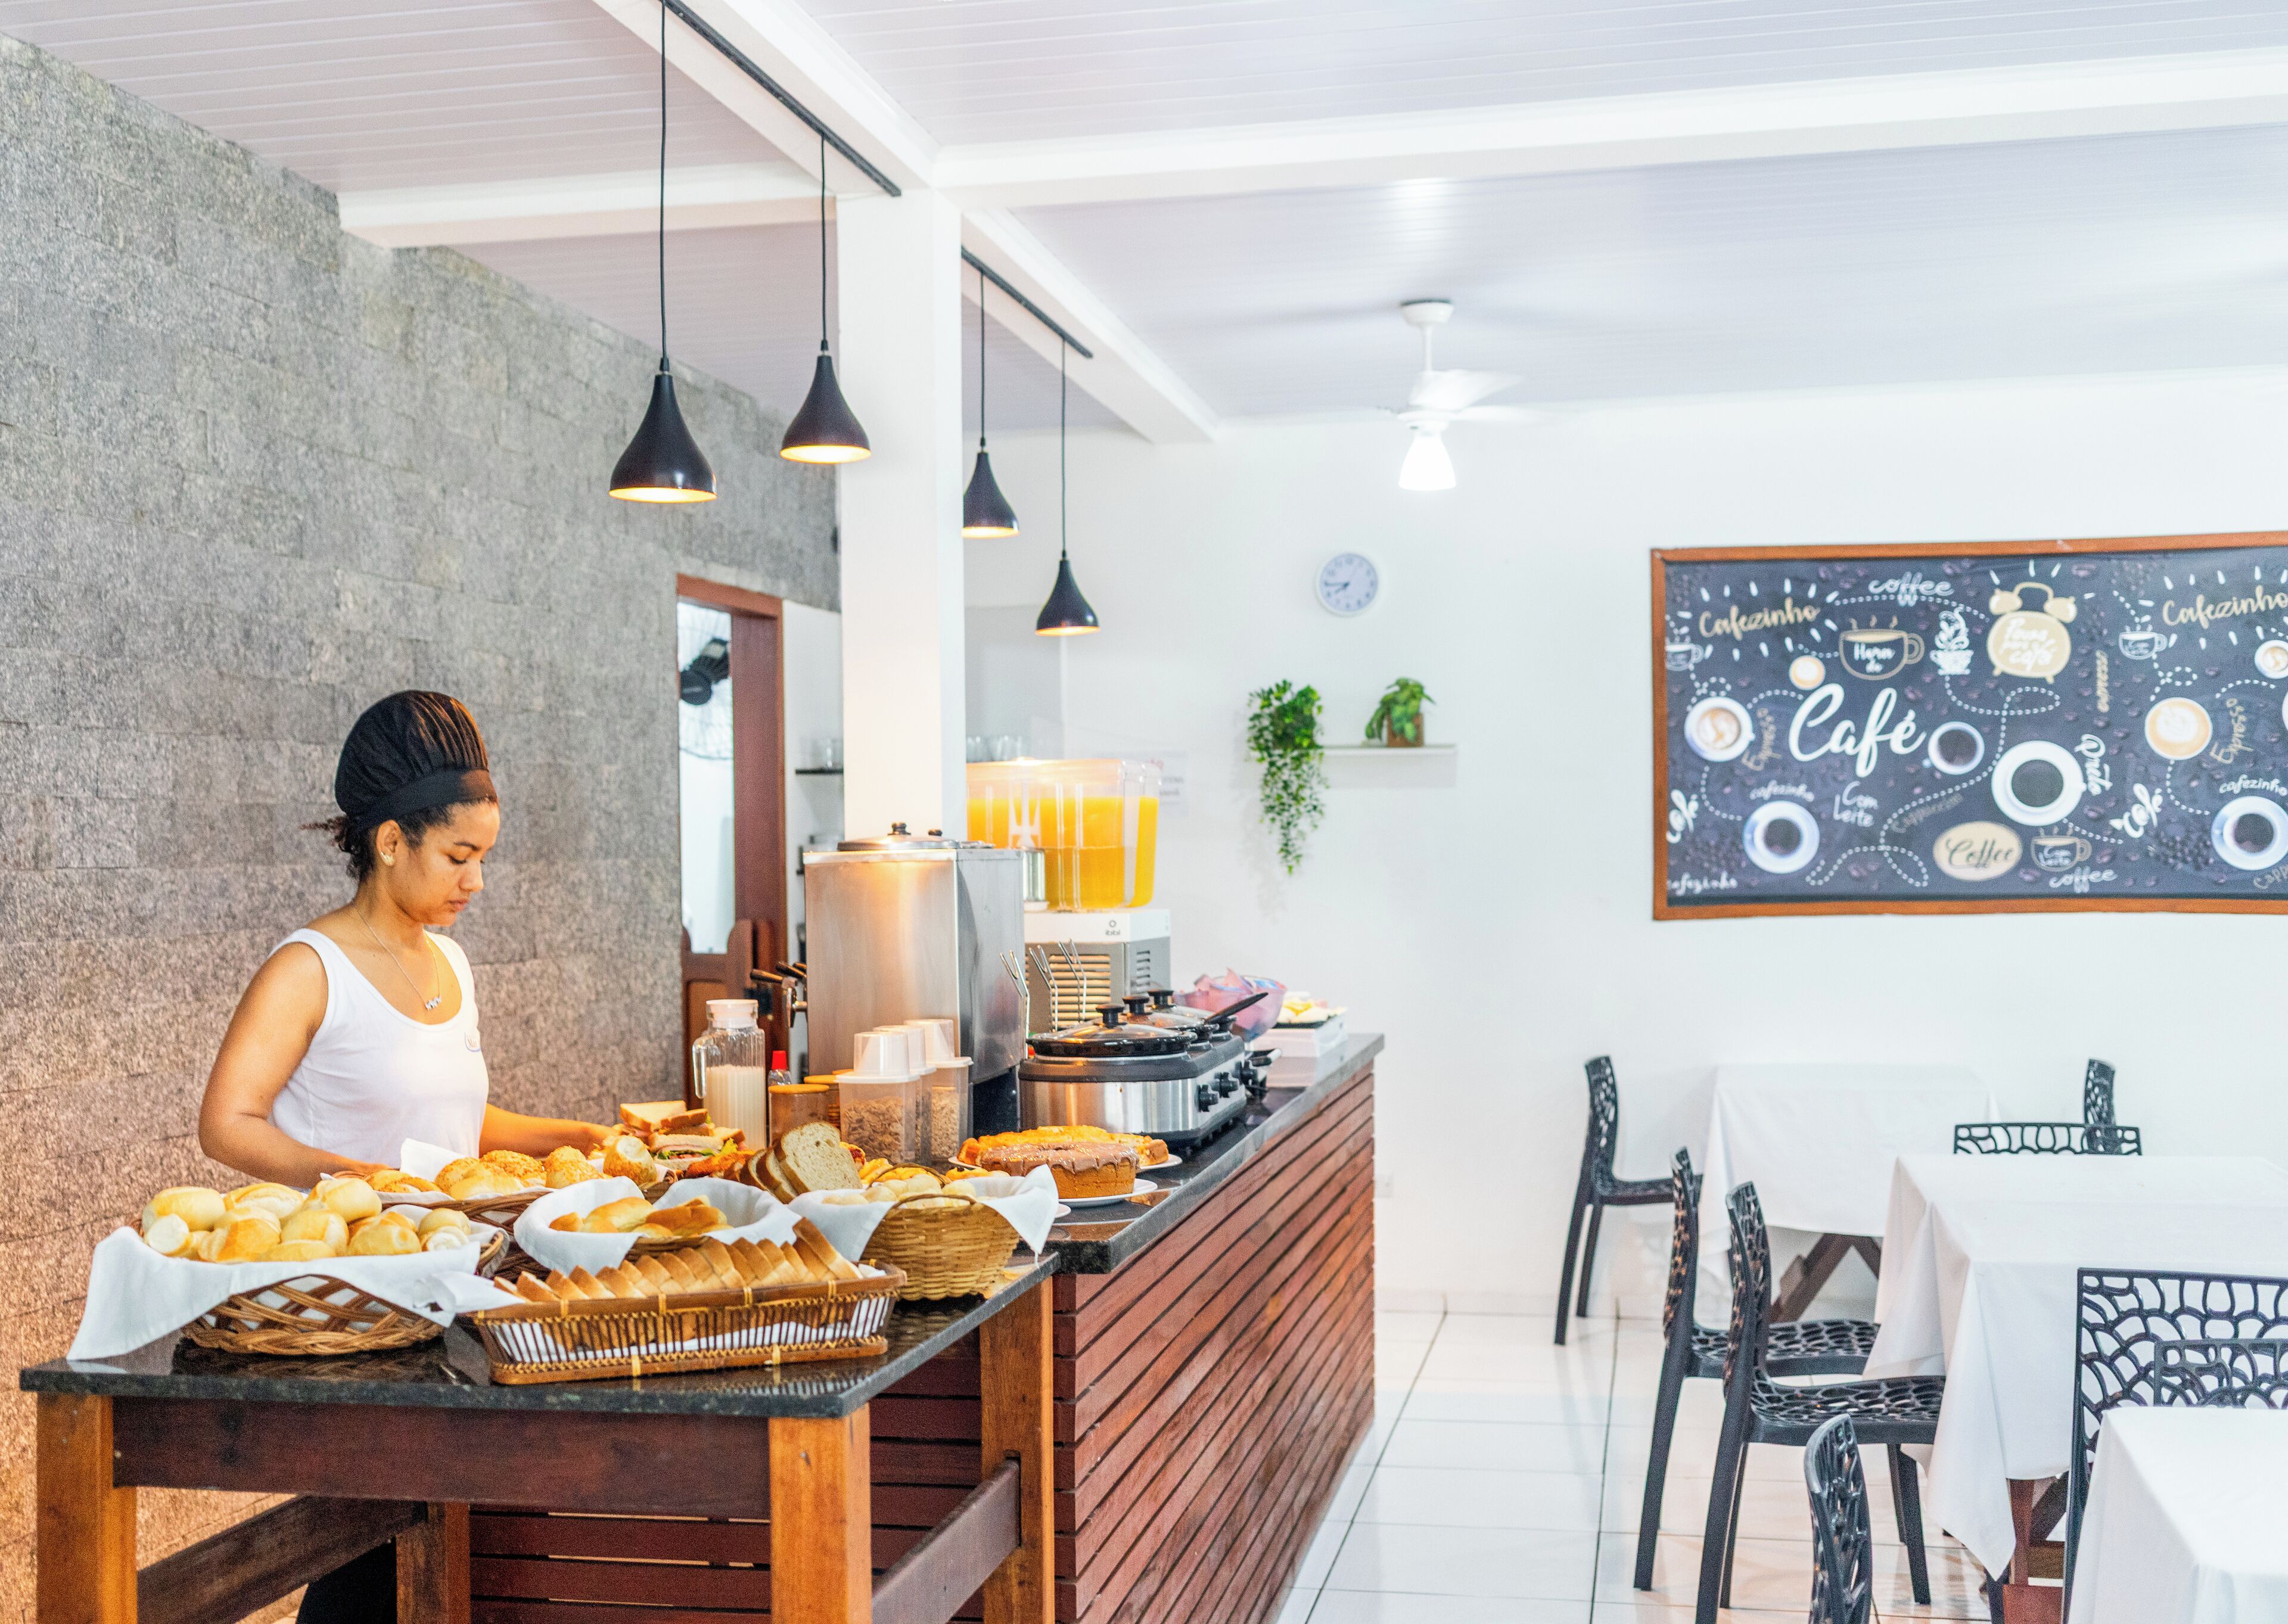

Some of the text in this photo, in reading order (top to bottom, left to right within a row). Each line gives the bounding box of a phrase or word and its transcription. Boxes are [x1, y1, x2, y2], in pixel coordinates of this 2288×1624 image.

[1868, 571, 1954, 607] coffee
[1699, 596, 1821, 641] Cafezinho
[2162, 585, 2288, 629] Cafezinho
[1789, 683, 1927, 777] Café
[2074, 734, 2113, 796] Preto
[1842, 780, 1879, 809] Com
[2219, 774, 2287, 796] cafezinho
[1833, 794, 1875, 827] Leite
[1945, 838, 2013, 869] Coffee
[2049, 866, 2117, 893] coffee
